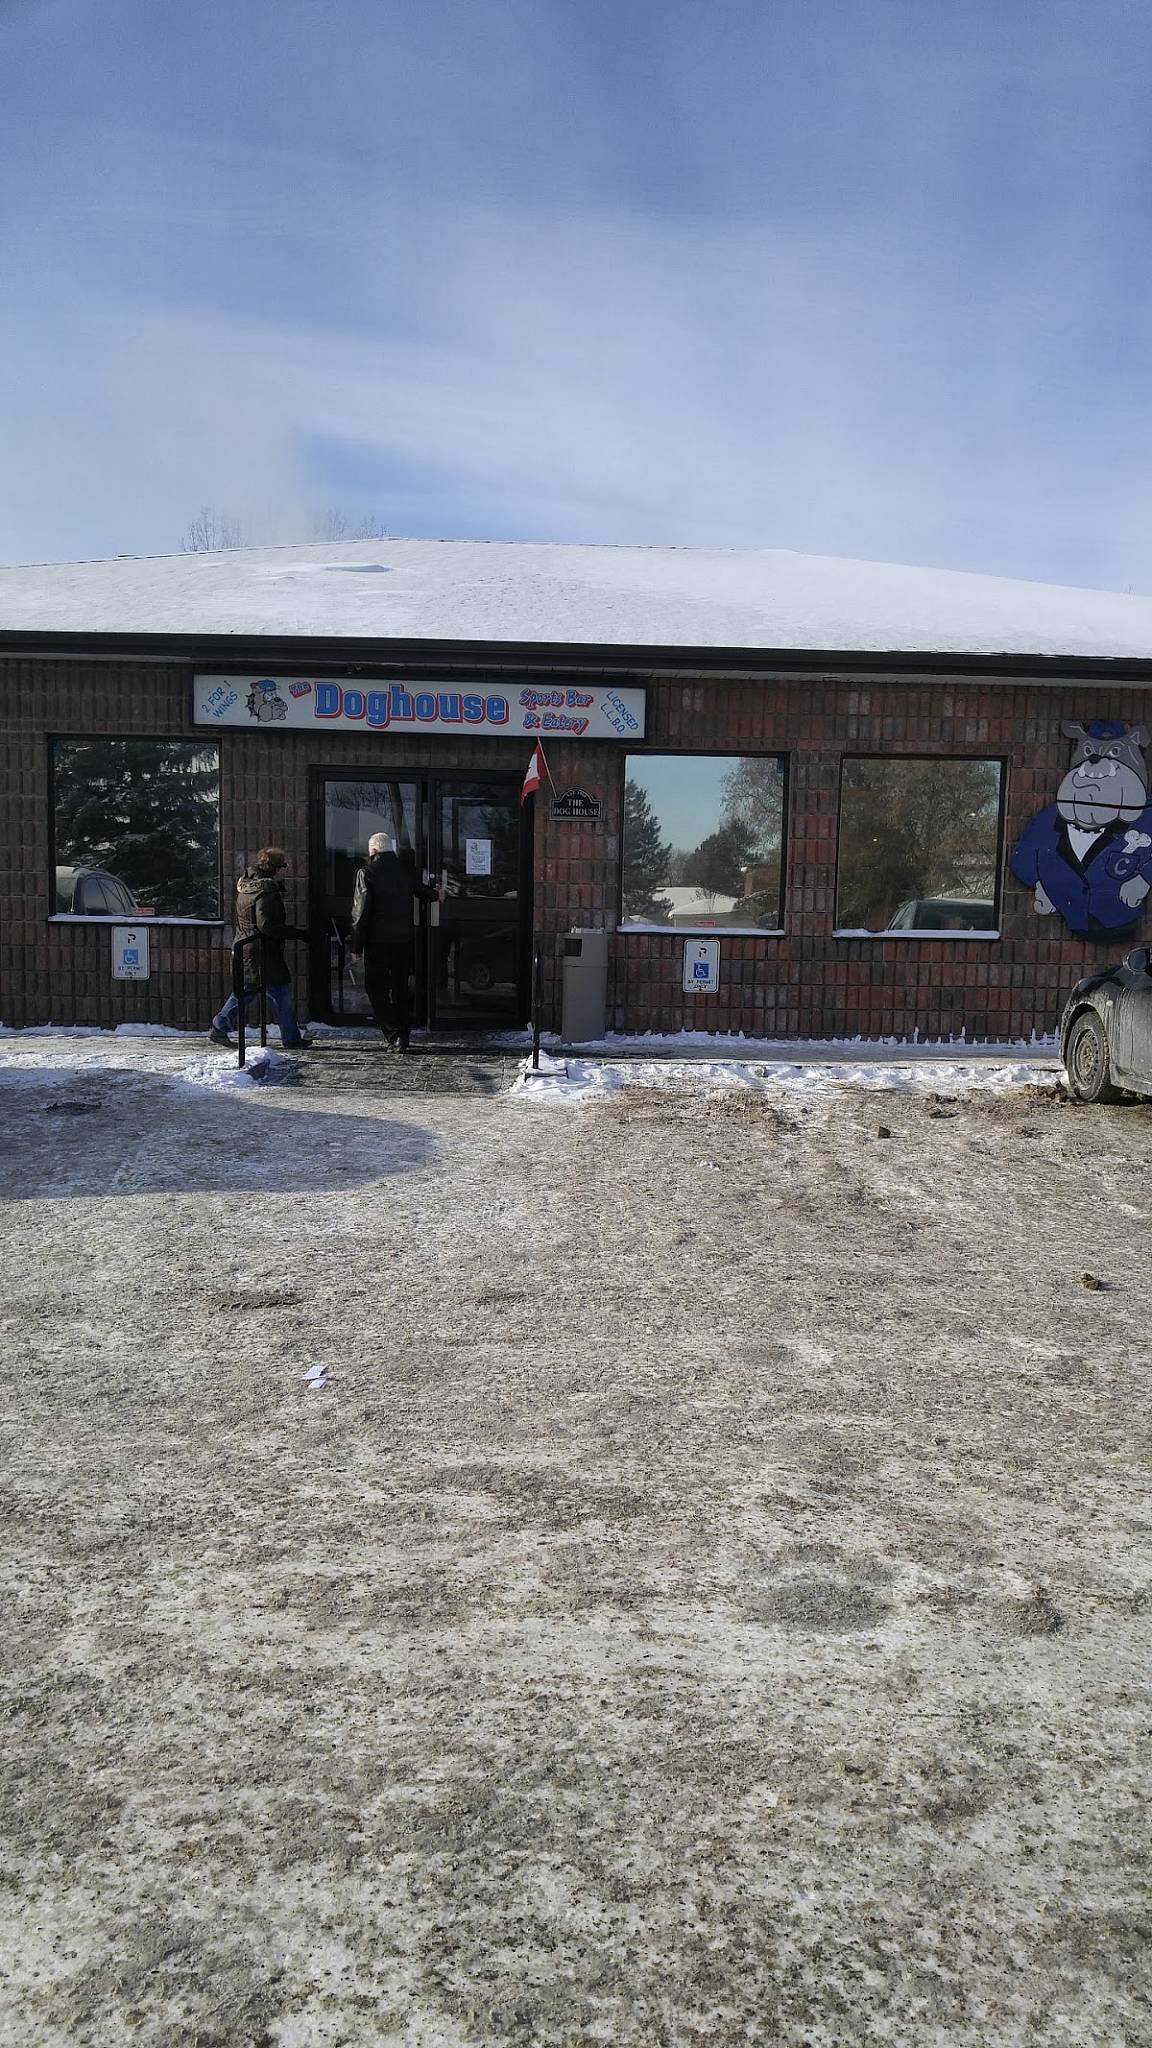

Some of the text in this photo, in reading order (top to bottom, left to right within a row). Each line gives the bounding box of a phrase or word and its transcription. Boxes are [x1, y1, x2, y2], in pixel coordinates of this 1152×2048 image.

[201, 680, 232, 713] 2 FOR 1
[212, 691, 239, 719] WINGS
[314, 681, 510, 730] Doghouse
[519, 688, 594, 711] Sports Bar
[606, 690, 639, 731] LICENSED
[522, 711, 590, 735] & Eatery
[553, 808, 599, 816] DOG HOUSE
[567, 799, 584, 807] THE
[1114, 857, 1130, 876] C
